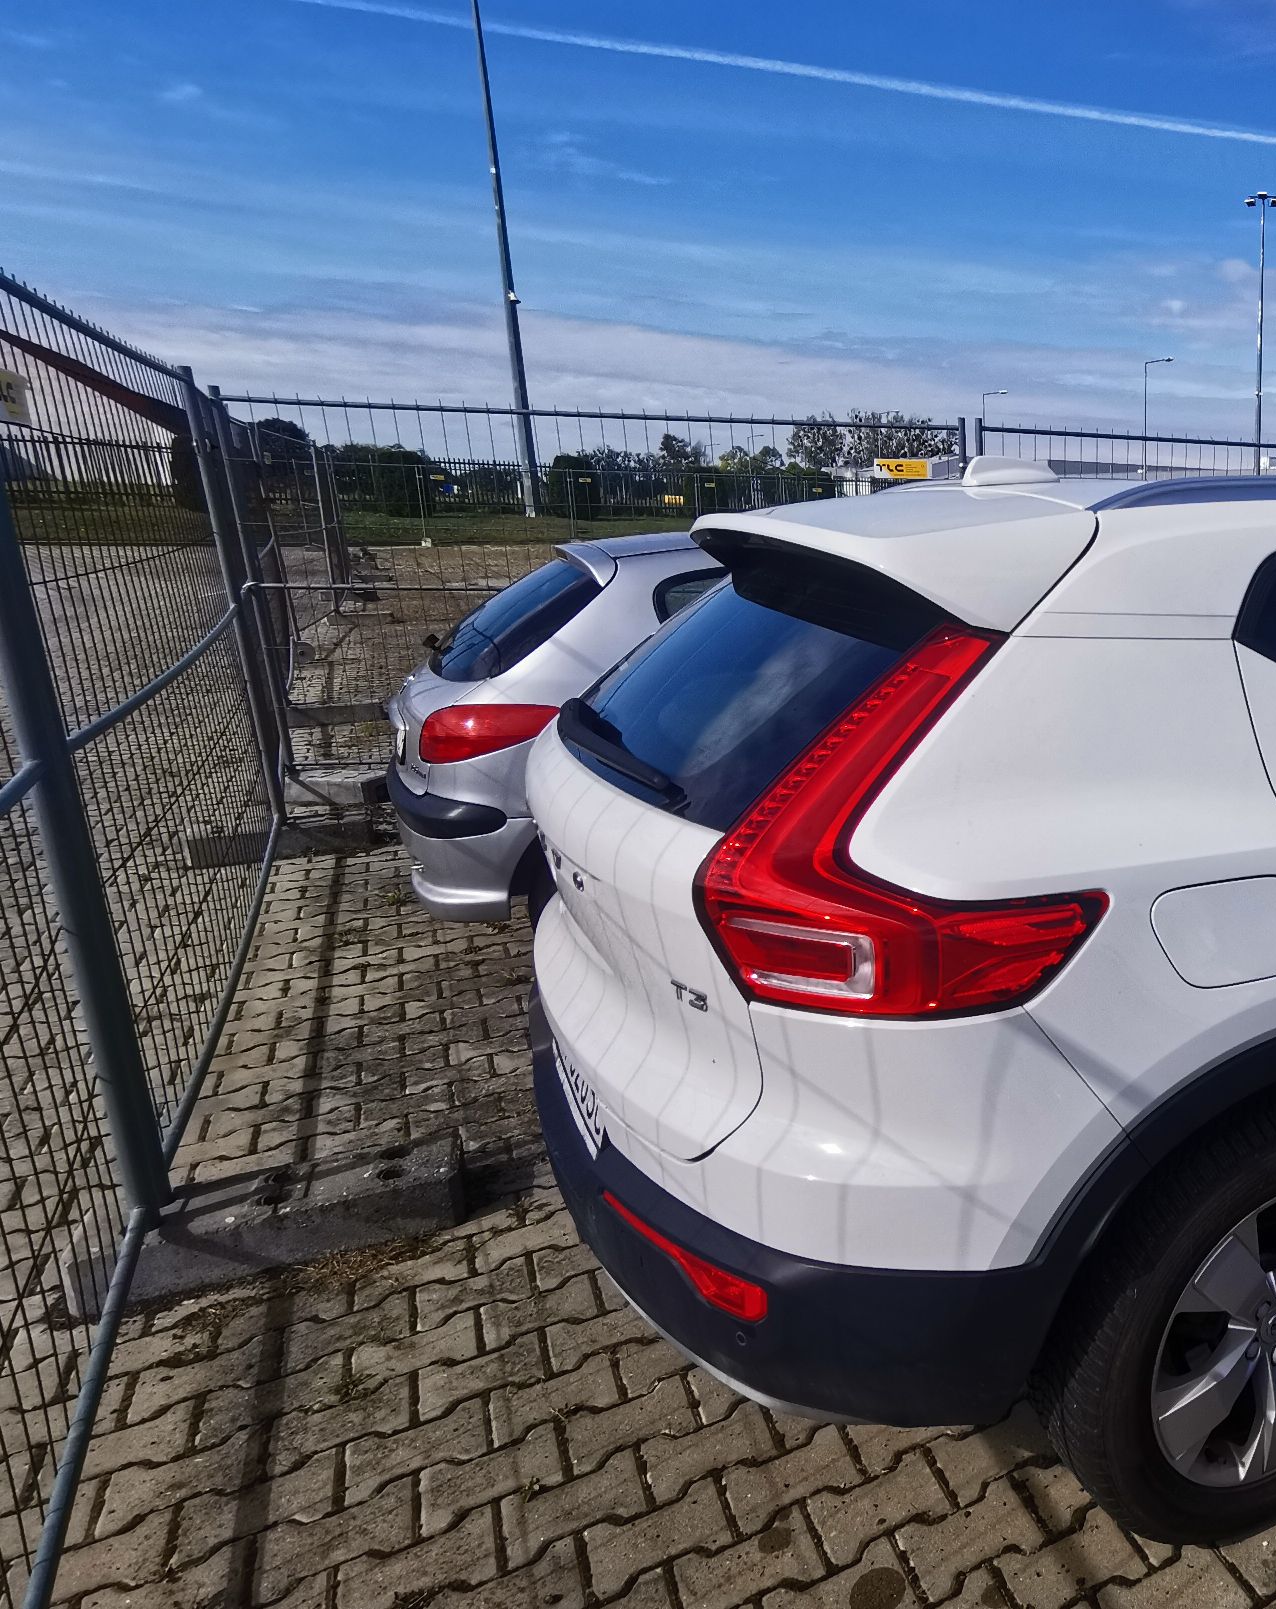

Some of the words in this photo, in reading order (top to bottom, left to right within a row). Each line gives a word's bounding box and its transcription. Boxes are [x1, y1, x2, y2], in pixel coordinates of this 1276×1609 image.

[0, 382, 16, 404] LC
[876, 463, 904, 473] TLC
[671, 978, 708, 1012] T3
